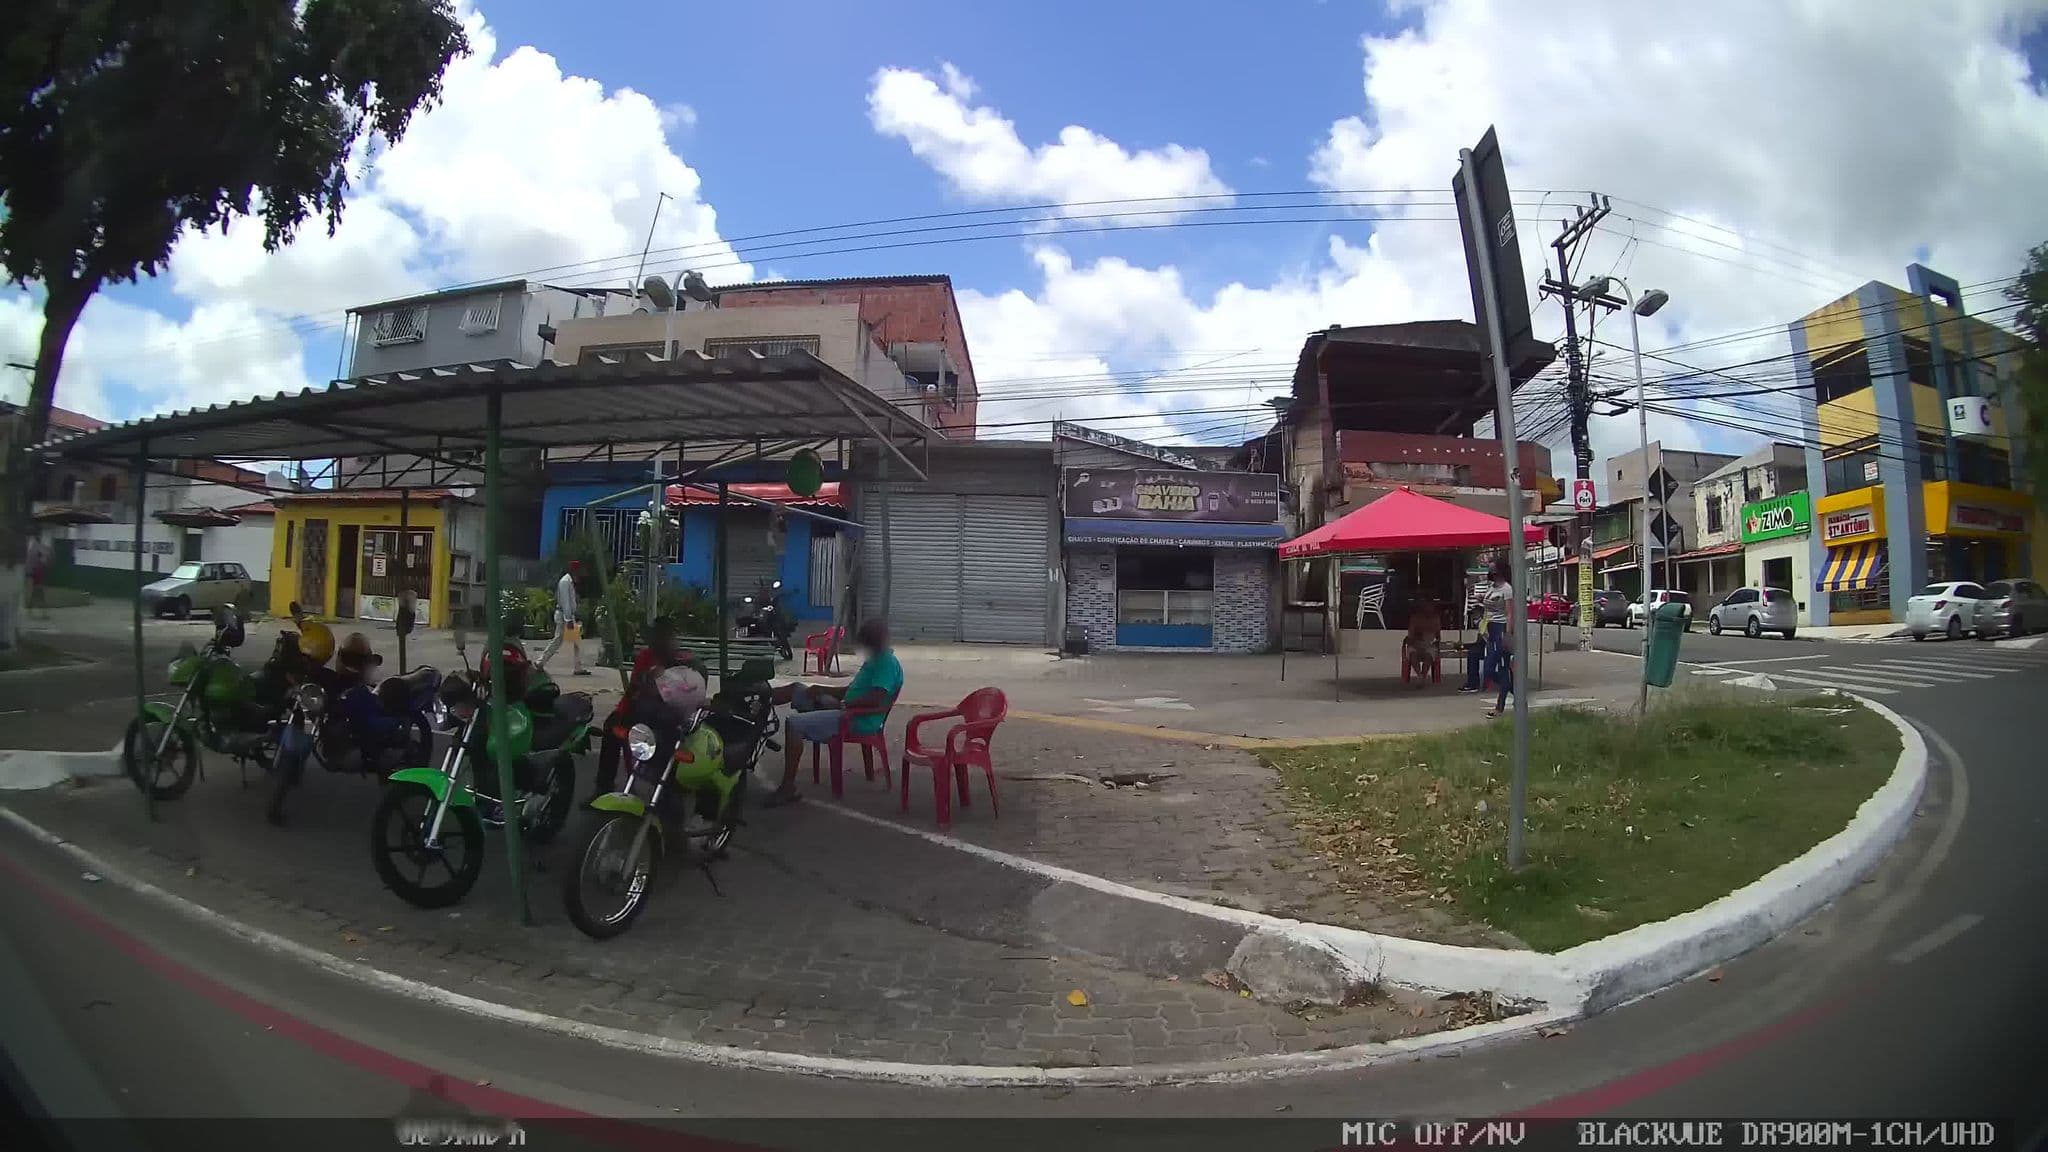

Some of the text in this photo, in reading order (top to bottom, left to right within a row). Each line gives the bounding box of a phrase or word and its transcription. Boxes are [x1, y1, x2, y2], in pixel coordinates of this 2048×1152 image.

[1135, 484, 1201, 497] CHAVEIRO
[1137, 494, 1196, 511] BAHIA
[1761, 506, 1794, 532] ZIMO
